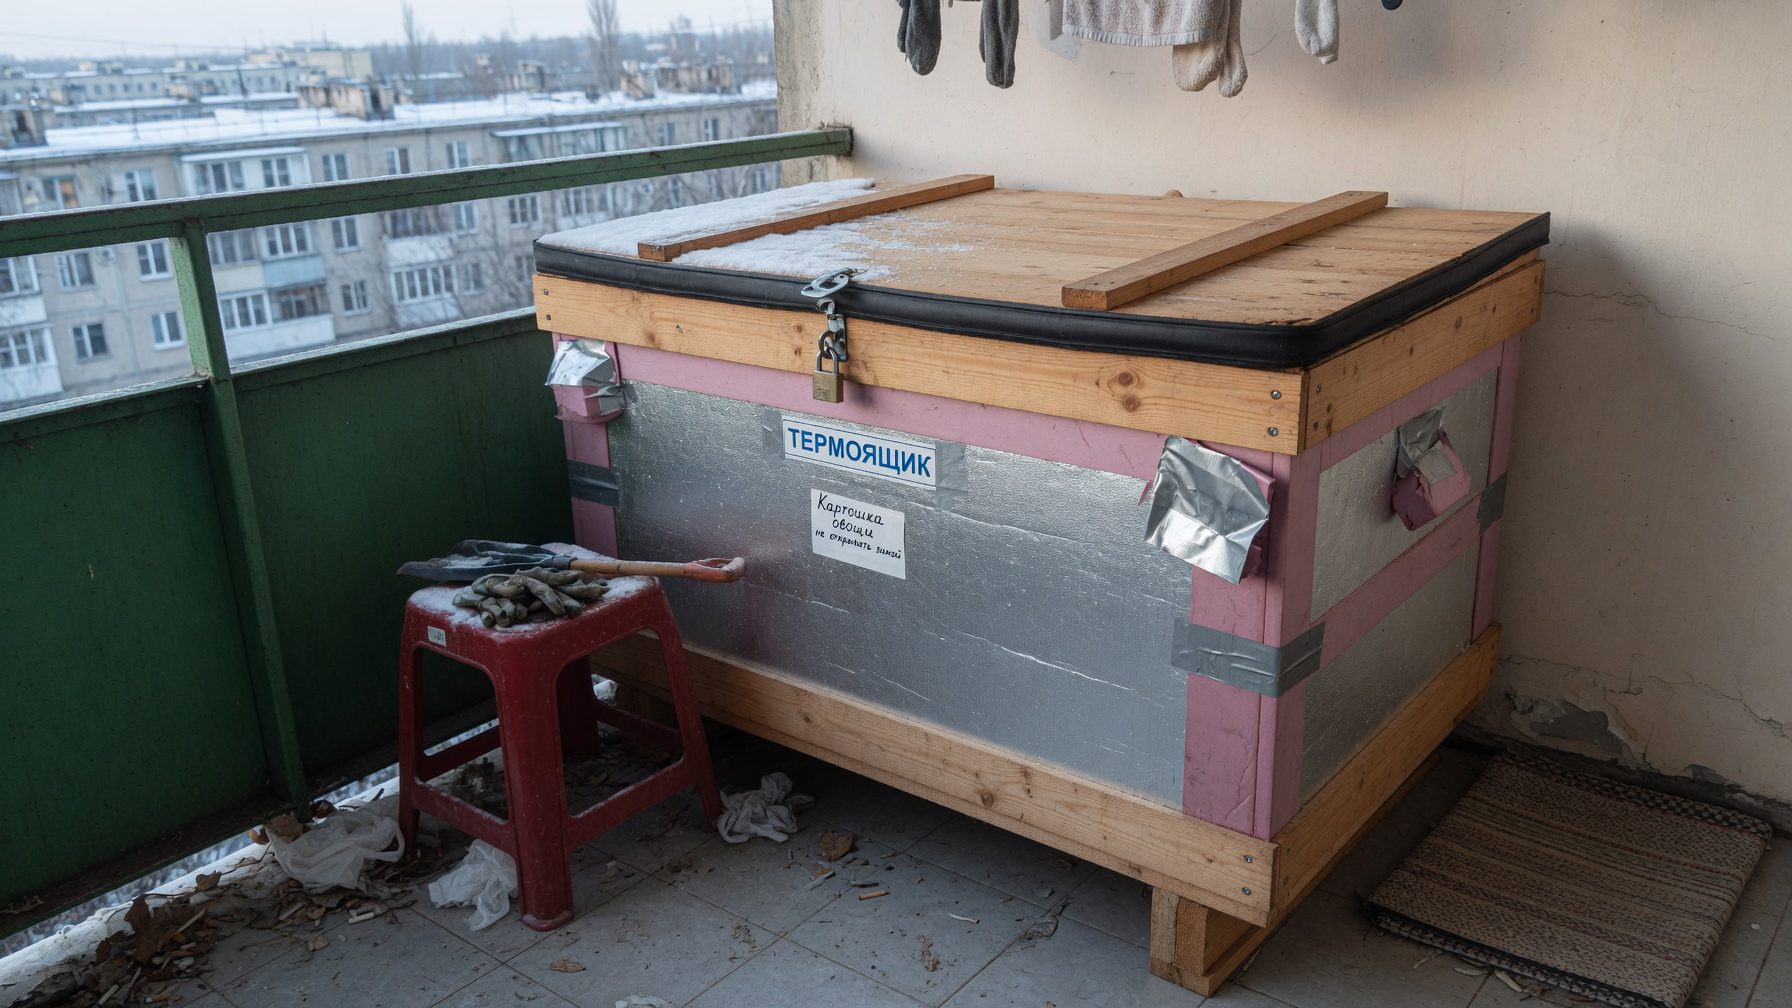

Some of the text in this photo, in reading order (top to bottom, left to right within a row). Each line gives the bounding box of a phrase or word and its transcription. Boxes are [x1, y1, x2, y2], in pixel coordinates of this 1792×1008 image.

[788, 428, 931, 477] ТЕРМОЯЩИК
[817, 492, 884, 525] Картошка
[815, 529, 825, 538] не
[832, 519, 873, 538] овощи
